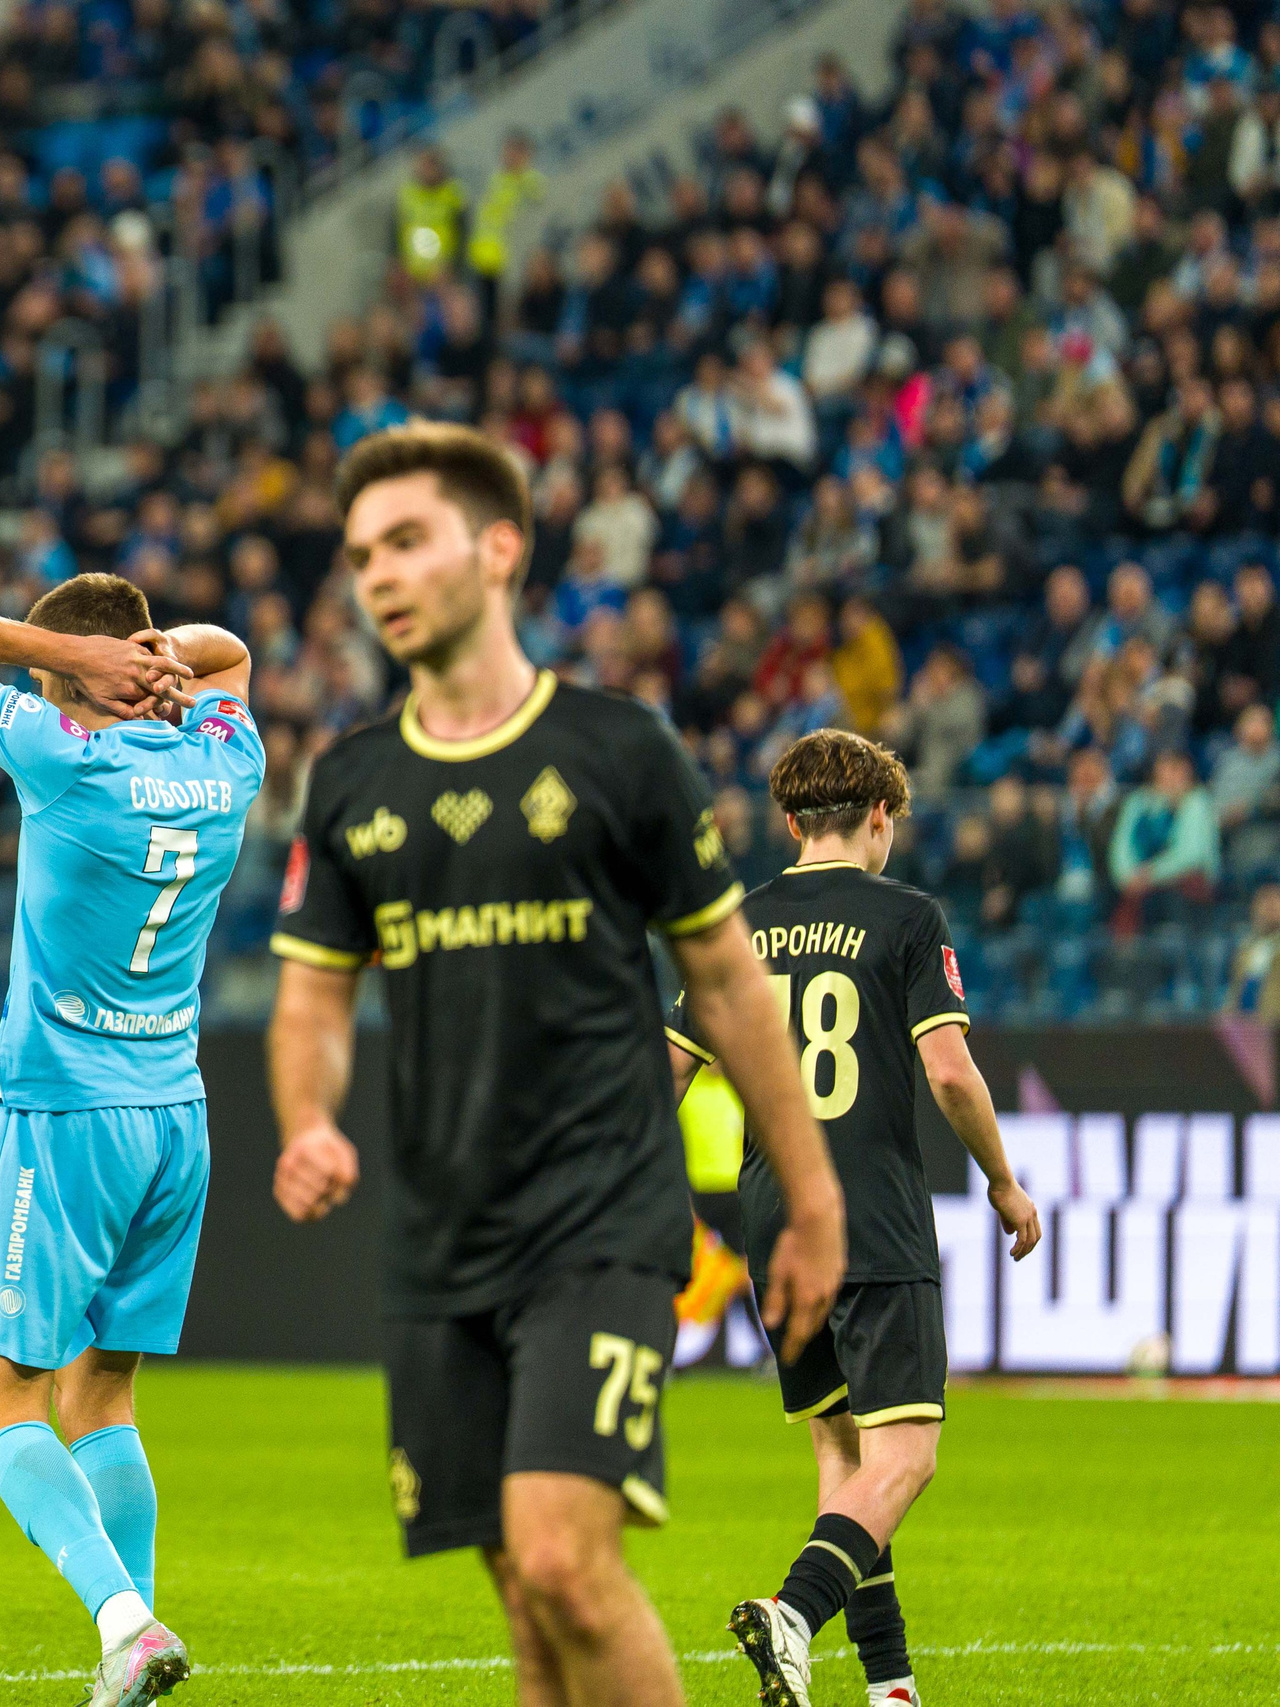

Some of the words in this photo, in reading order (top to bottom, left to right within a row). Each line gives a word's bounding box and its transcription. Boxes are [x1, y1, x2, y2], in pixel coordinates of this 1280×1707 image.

[1, 690, 22, 726] РОМБАНК
[130, 776, 233, 814] СОБОЛЕВ
[129, 825, 199, 973] 7
[417, 898, 594, 954] МАГНИТ
[751, 921, 867, 961] ОРОНИН
[4, 1166, 35, 1281] ГАЗПРОМБАНК
[588, 1330, 664, 1451] 75
